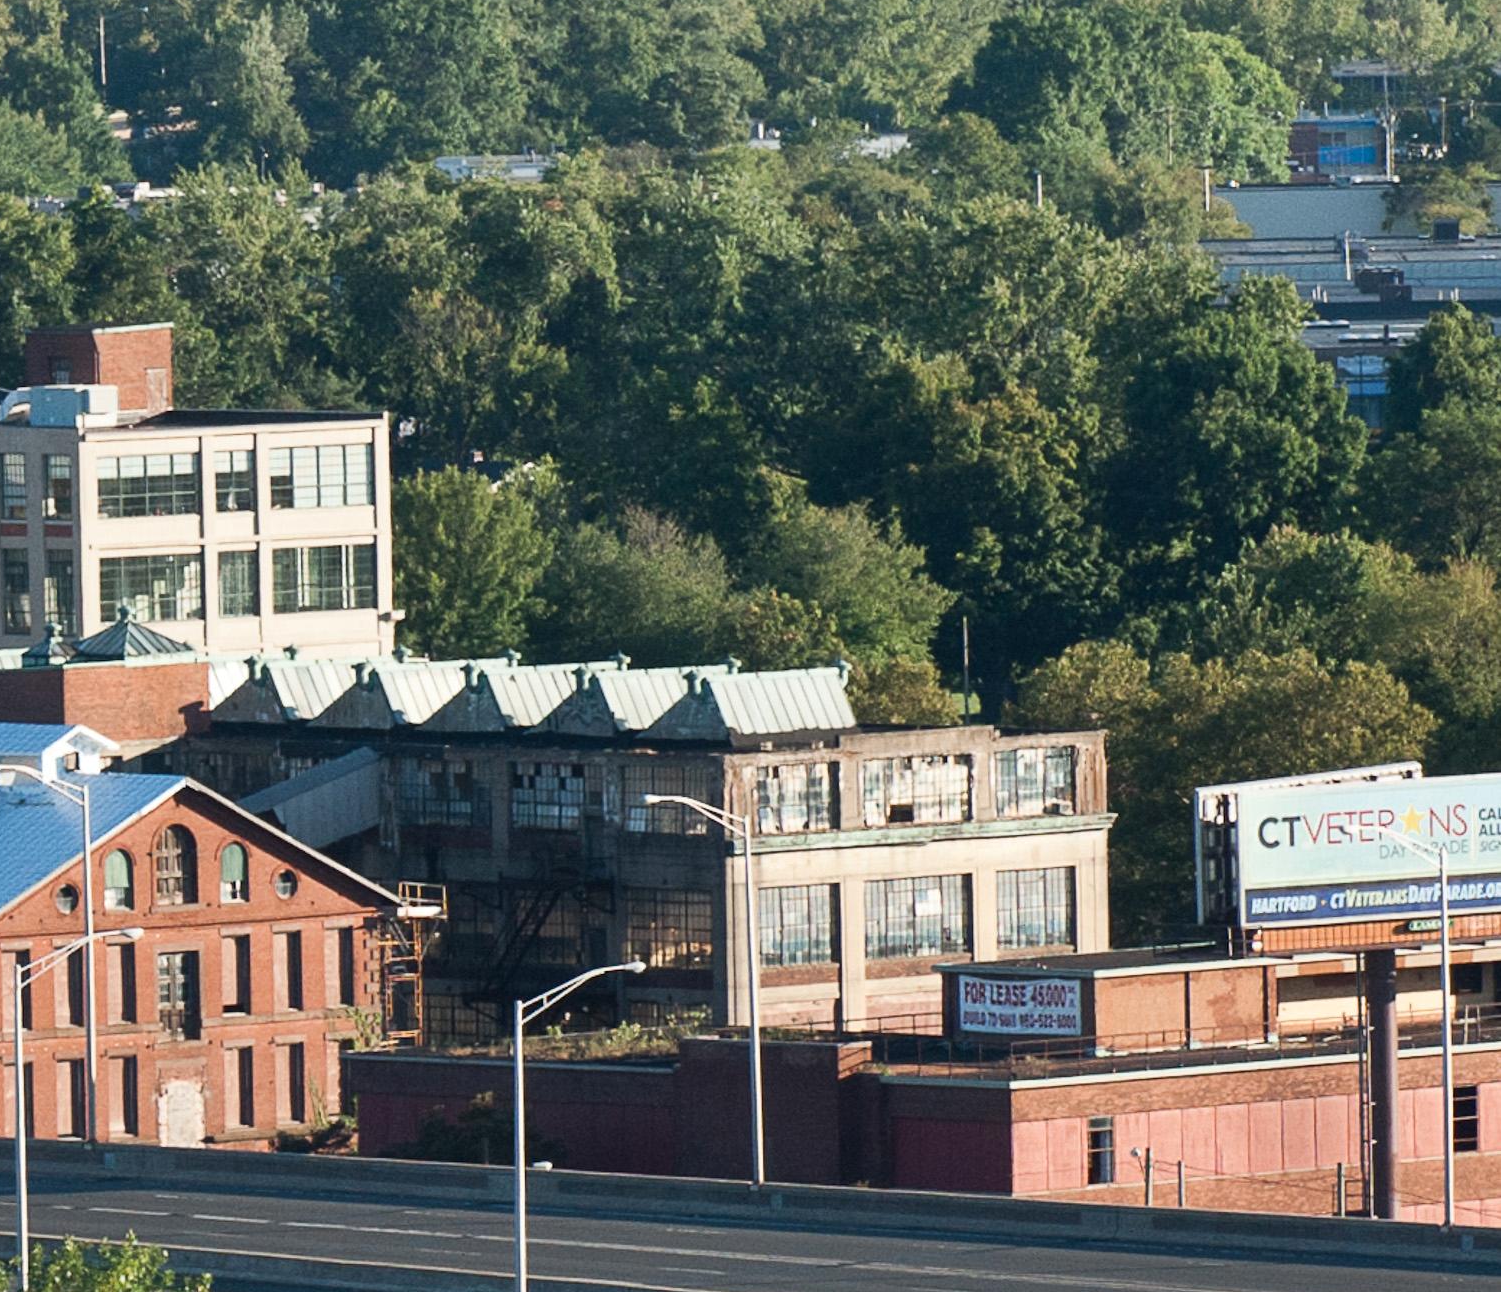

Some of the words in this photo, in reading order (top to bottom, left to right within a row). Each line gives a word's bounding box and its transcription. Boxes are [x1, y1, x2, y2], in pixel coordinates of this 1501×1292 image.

[1379, 843, 1407, 860] DAY
[1251, 894, 1317, 915] HARTFORD
[964, 981, 986, 1005] FOR
[990, 983, 1027, 1007] LEASE
